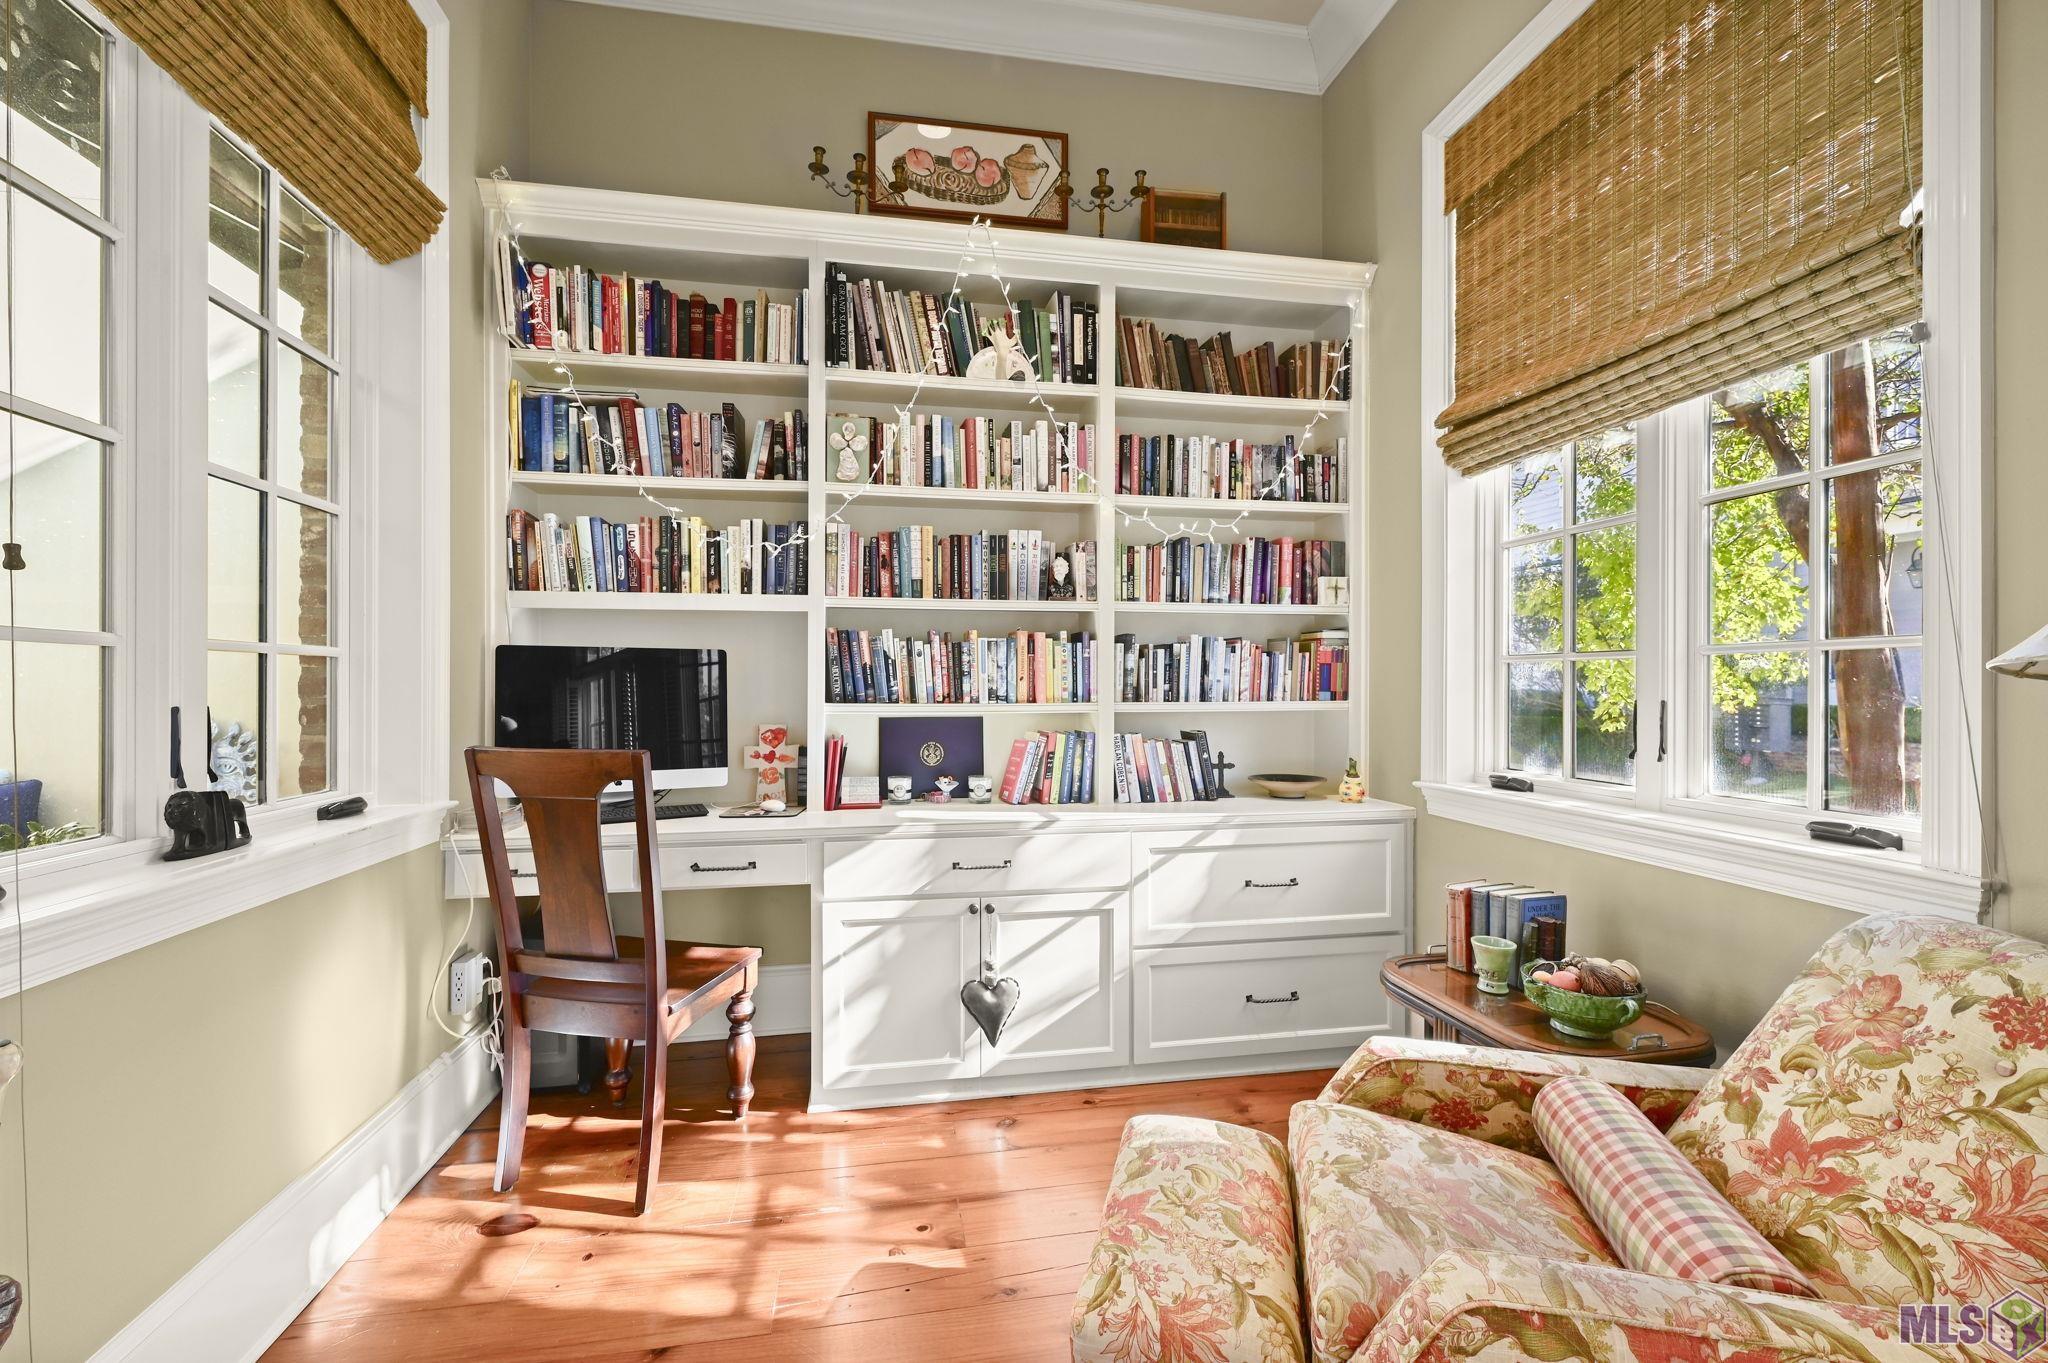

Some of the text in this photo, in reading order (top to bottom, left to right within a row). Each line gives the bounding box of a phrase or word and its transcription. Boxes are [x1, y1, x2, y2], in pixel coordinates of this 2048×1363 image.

[838, 284, 848, 358] GRAND SLAM GOLF
[841, 641, 850, 672] HOSTAGE
[852, 642, 862, 678] BIBLIOPHILE
[831, 664, 841, 694] ABDUCTION
[1114, 736, 1123, 761] HARLAN
[1116, 762, 1126, 784] COBEN
[1527, 903, 1562, 913] UNDER THE
